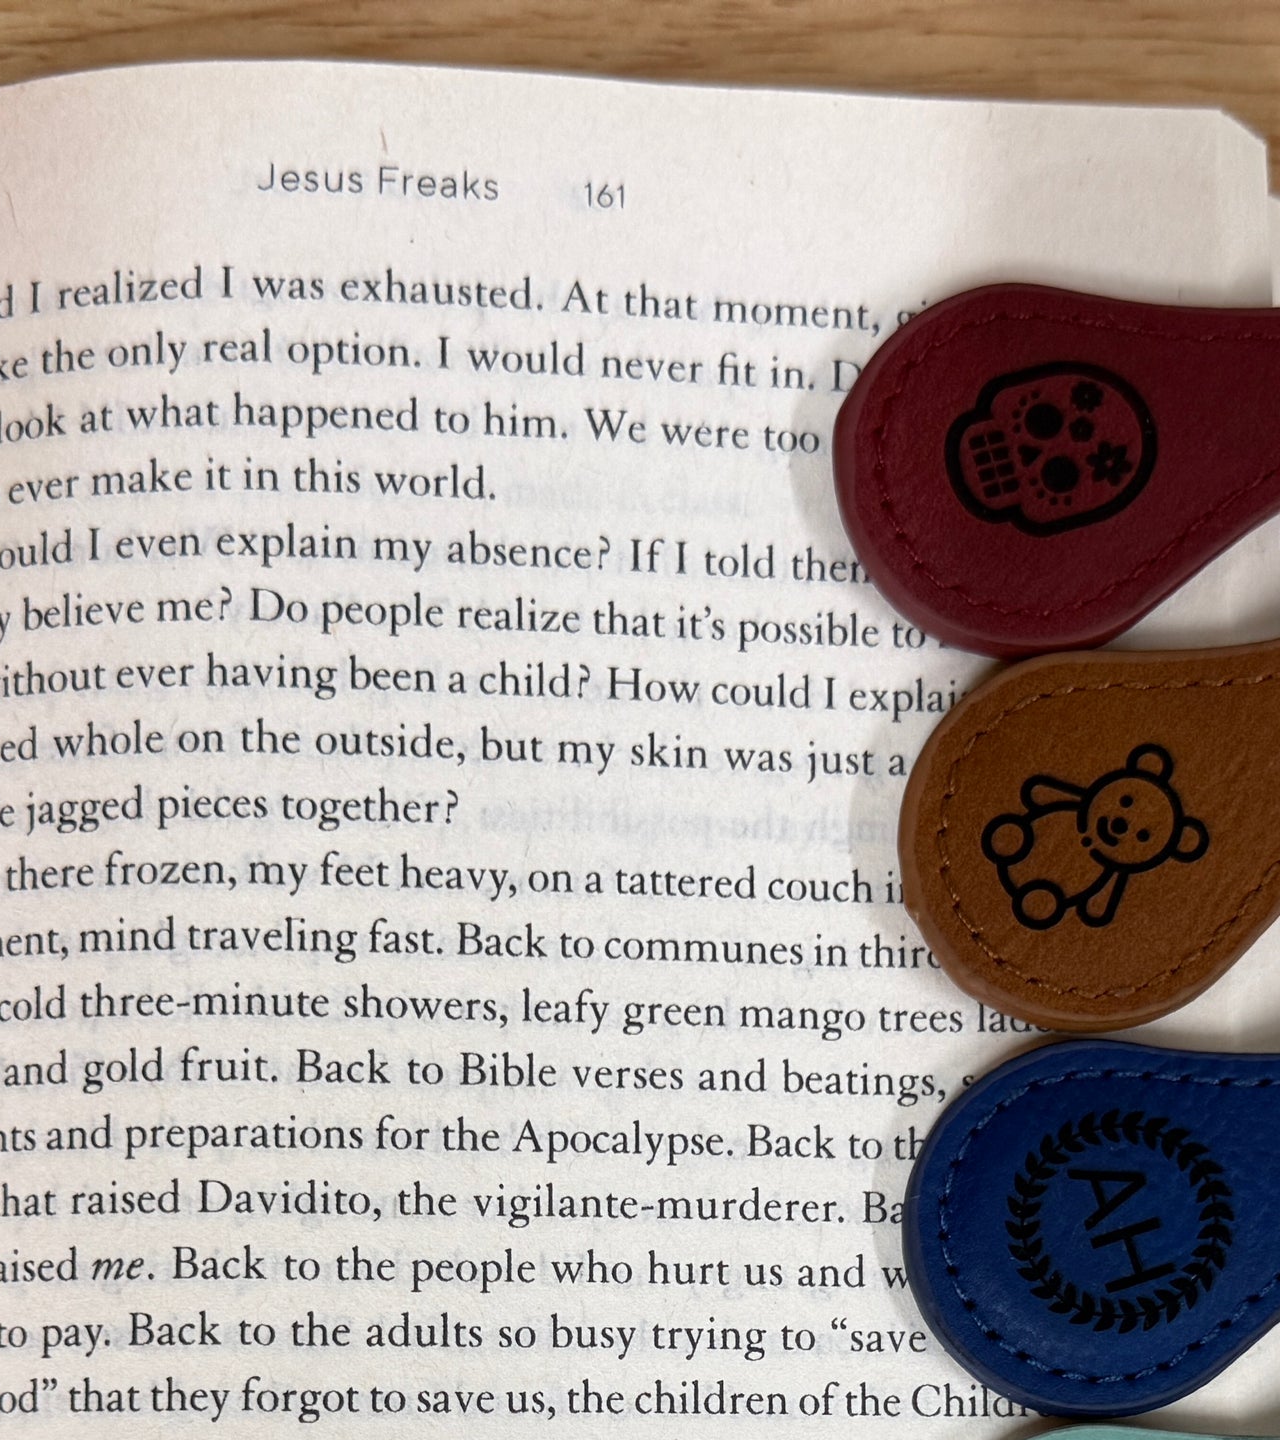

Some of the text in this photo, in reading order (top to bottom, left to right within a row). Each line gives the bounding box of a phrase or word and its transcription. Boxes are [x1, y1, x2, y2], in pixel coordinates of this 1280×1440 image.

[257, 163, 499, 201] Jesus Freaks
[584, 182, 625, 209] 161
[41, 338, 95, 375] the
[107, 330, 187, 375] only
[203, 327, 272, 363] real
[287, 339, 421, 376] option.
[438, 335, 449, 369] I
[467, 340, 584, 377] would
[601, 356, 703, 383] never
[718, 351, 756, 387] fit
[771, 366, 815, 391] in.
[23, 592, 145, 631] believe
[157, 585, 233, 622] me?
[249, 587, 309, 624] Do
[321, 591, 444, 637] people
[457, 595, 580, 634] realize
[593, 600, 666, 638] that
[677, 605, 725, 641] it’s
[738, 611, 879, 653] possible
[892, 622, 926, 648] to
[3, 1048, 69, 1087] and
[82, 1046, 165, 1095] gold
[180, 1045, 278, 1083] fruit.
[296, 1048, 391, 1084] Back
[407, 1058, 444, 1086] to
[459, 1051, 557, 1088] Bible
[572, 1065, 684, 1091] verses
[698, 1057, 767, 1093] and
[782, 1058, 946, 1108] beatings,
[1065, 1167, 1177, 1295] AH
[40, 1324, 111, 1359] pay.
[128, 1310, 222, 1347] Back
[238, 1319, 276, 1347] to
[291, 1310, 351, 1347] the
[365, 1311, 483, 1348] adults
[498, 1325, 537, 1349] so
[550, 1312, 637, 1361] busy
[651, 1323, 767, 1362] trying
[780, 1325, 816, 1351] to
[831, 1317, 927, 1353] “save
